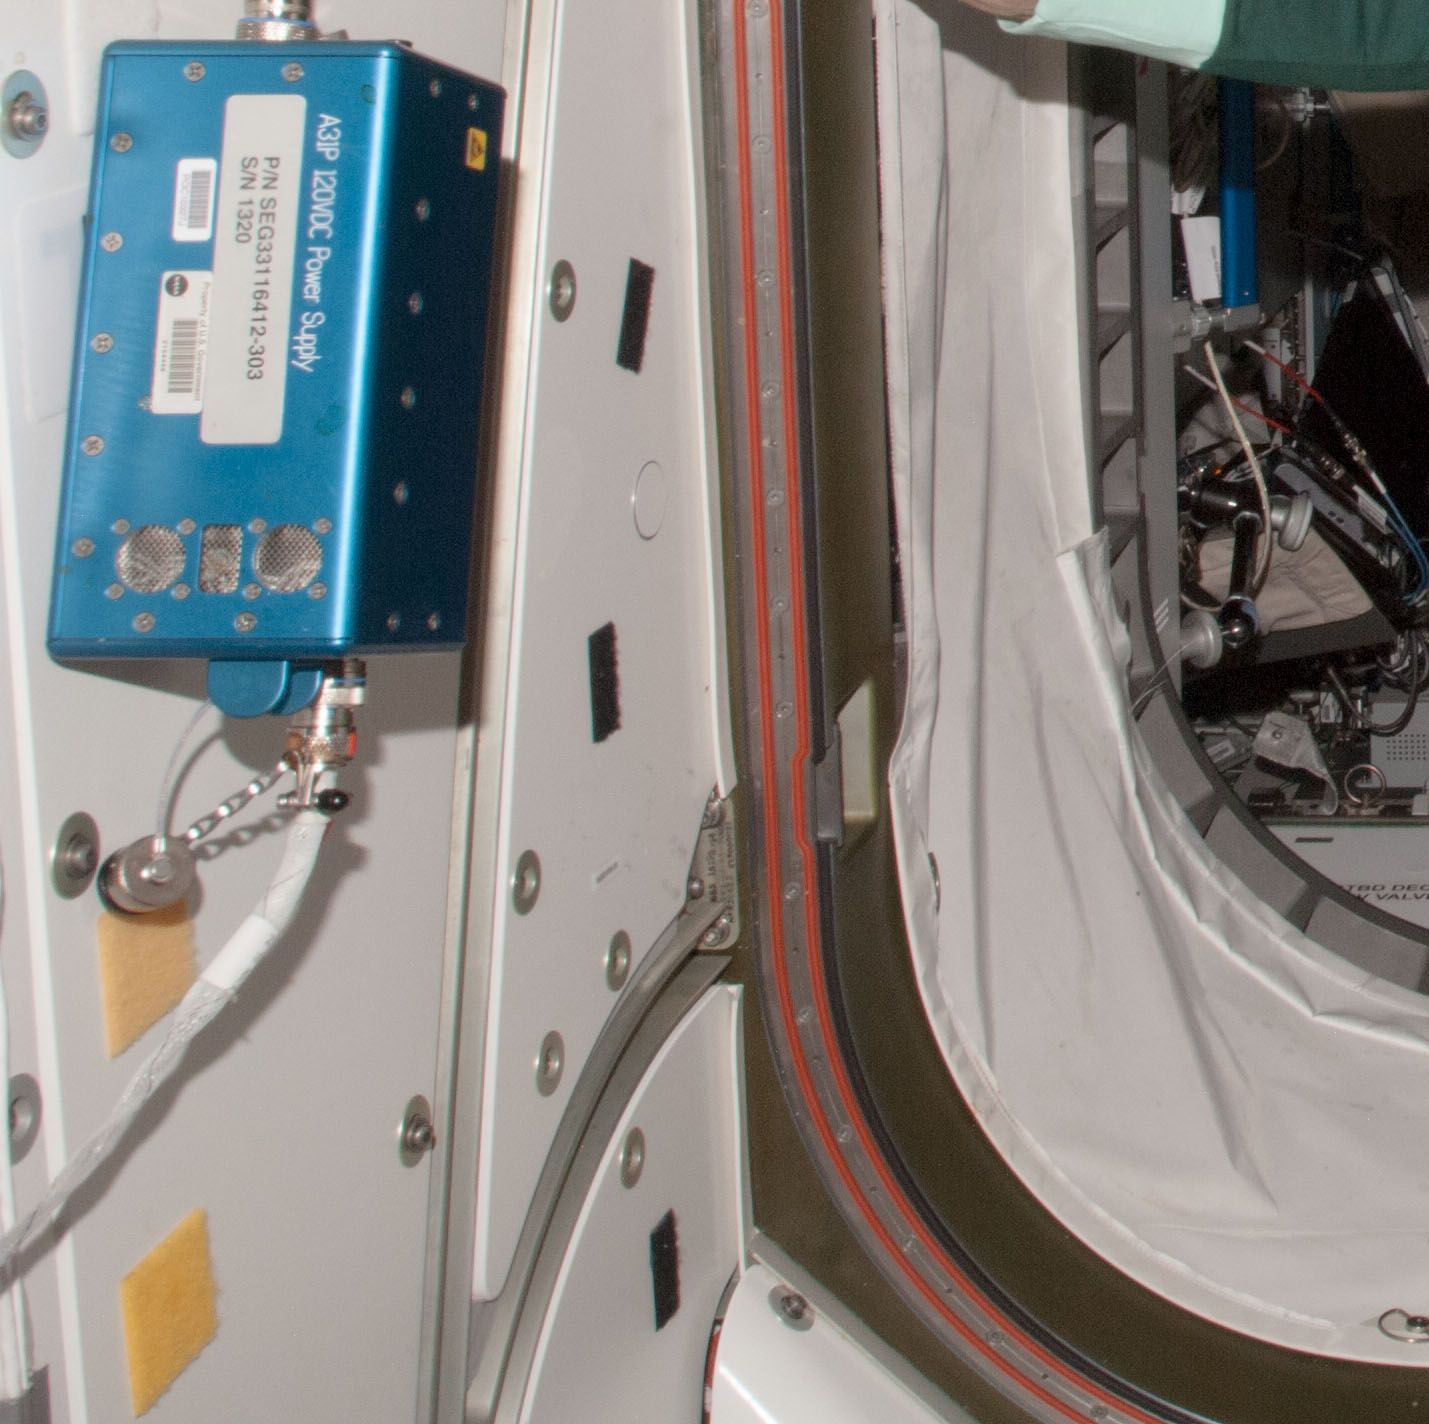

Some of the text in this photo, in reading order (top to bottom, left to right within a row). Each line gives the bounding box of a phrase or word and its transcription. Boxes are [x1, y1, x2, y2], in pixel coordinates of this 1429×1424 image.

[235, 156, 259, 244] S/N 1320
[247, 156, 281, 381] P/N SEG33116412-303
[303, 247, 331, 303] Power
[291, 311, 326, 372] Supply
